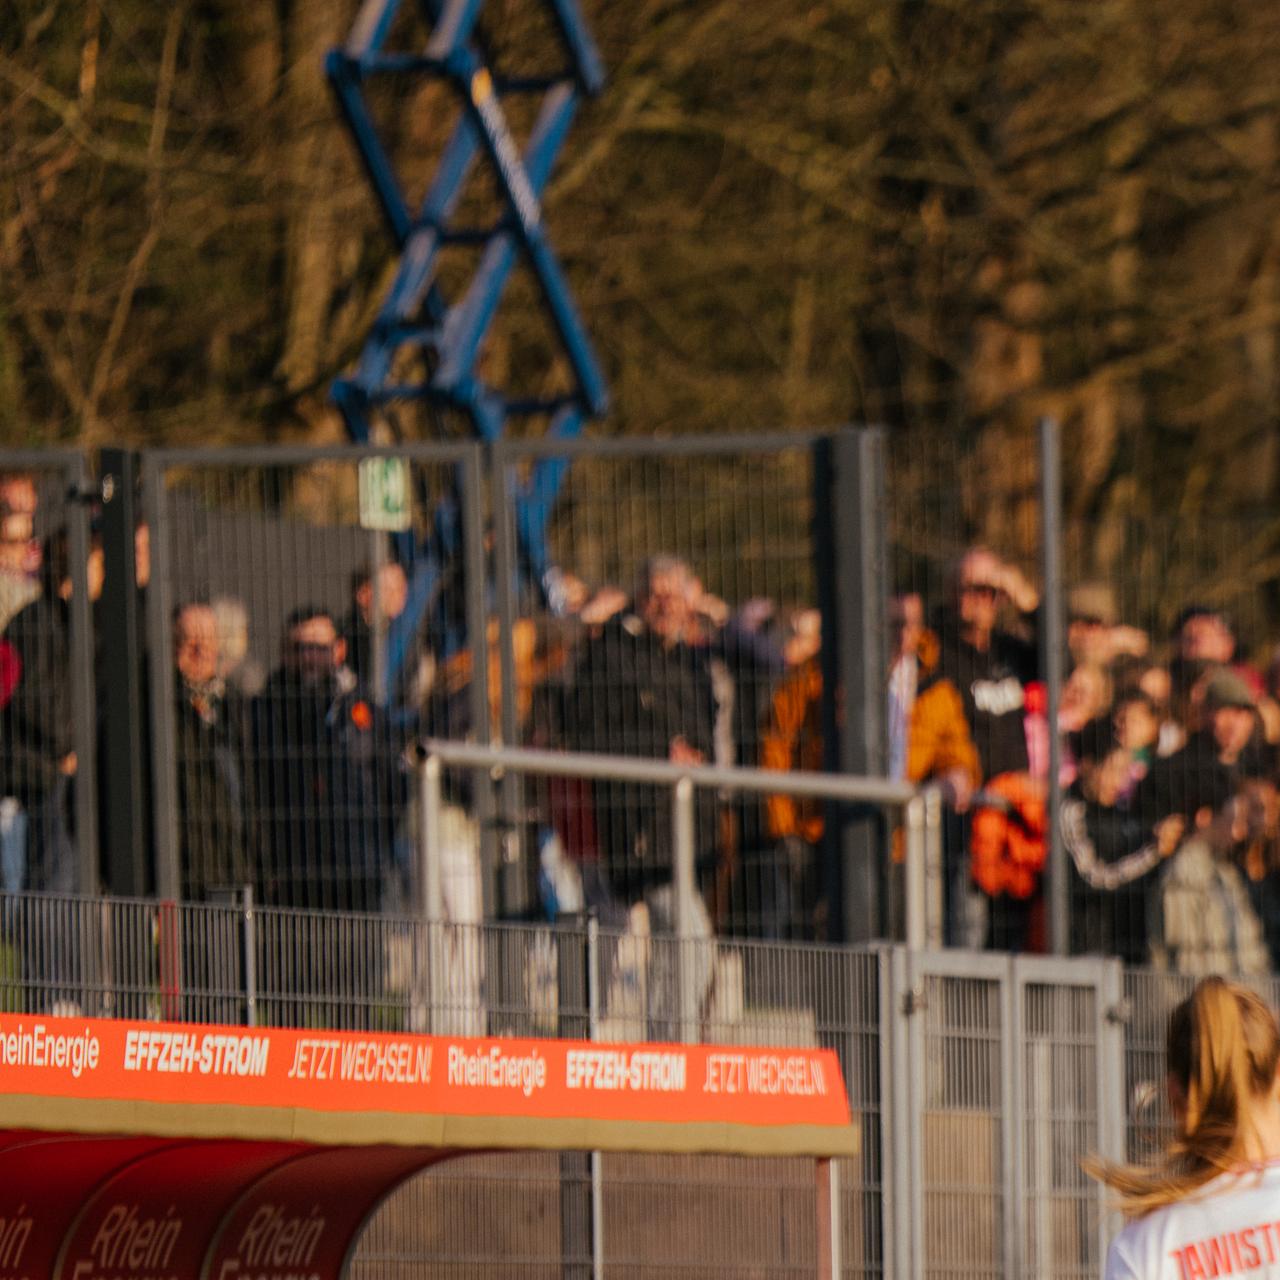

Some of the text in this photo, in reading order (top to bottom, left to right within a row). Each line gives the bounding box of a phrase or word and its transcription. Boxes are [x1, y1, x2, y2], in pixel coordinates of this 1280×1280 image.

[125, 1030, 269, 1076] EFFZEH-STROM
[288, 1039, 341, 1079] JETZT
[341, 1041, 432, 1083] WECHSELN!
[448, 1046, 546, 1096] RheinEnergie
[566, 1050, 686, 1092] EFFZEH-STROM
[92, 1204, 182, 1268] Rhein
[239, 1204, 326, 1268] Rhein
